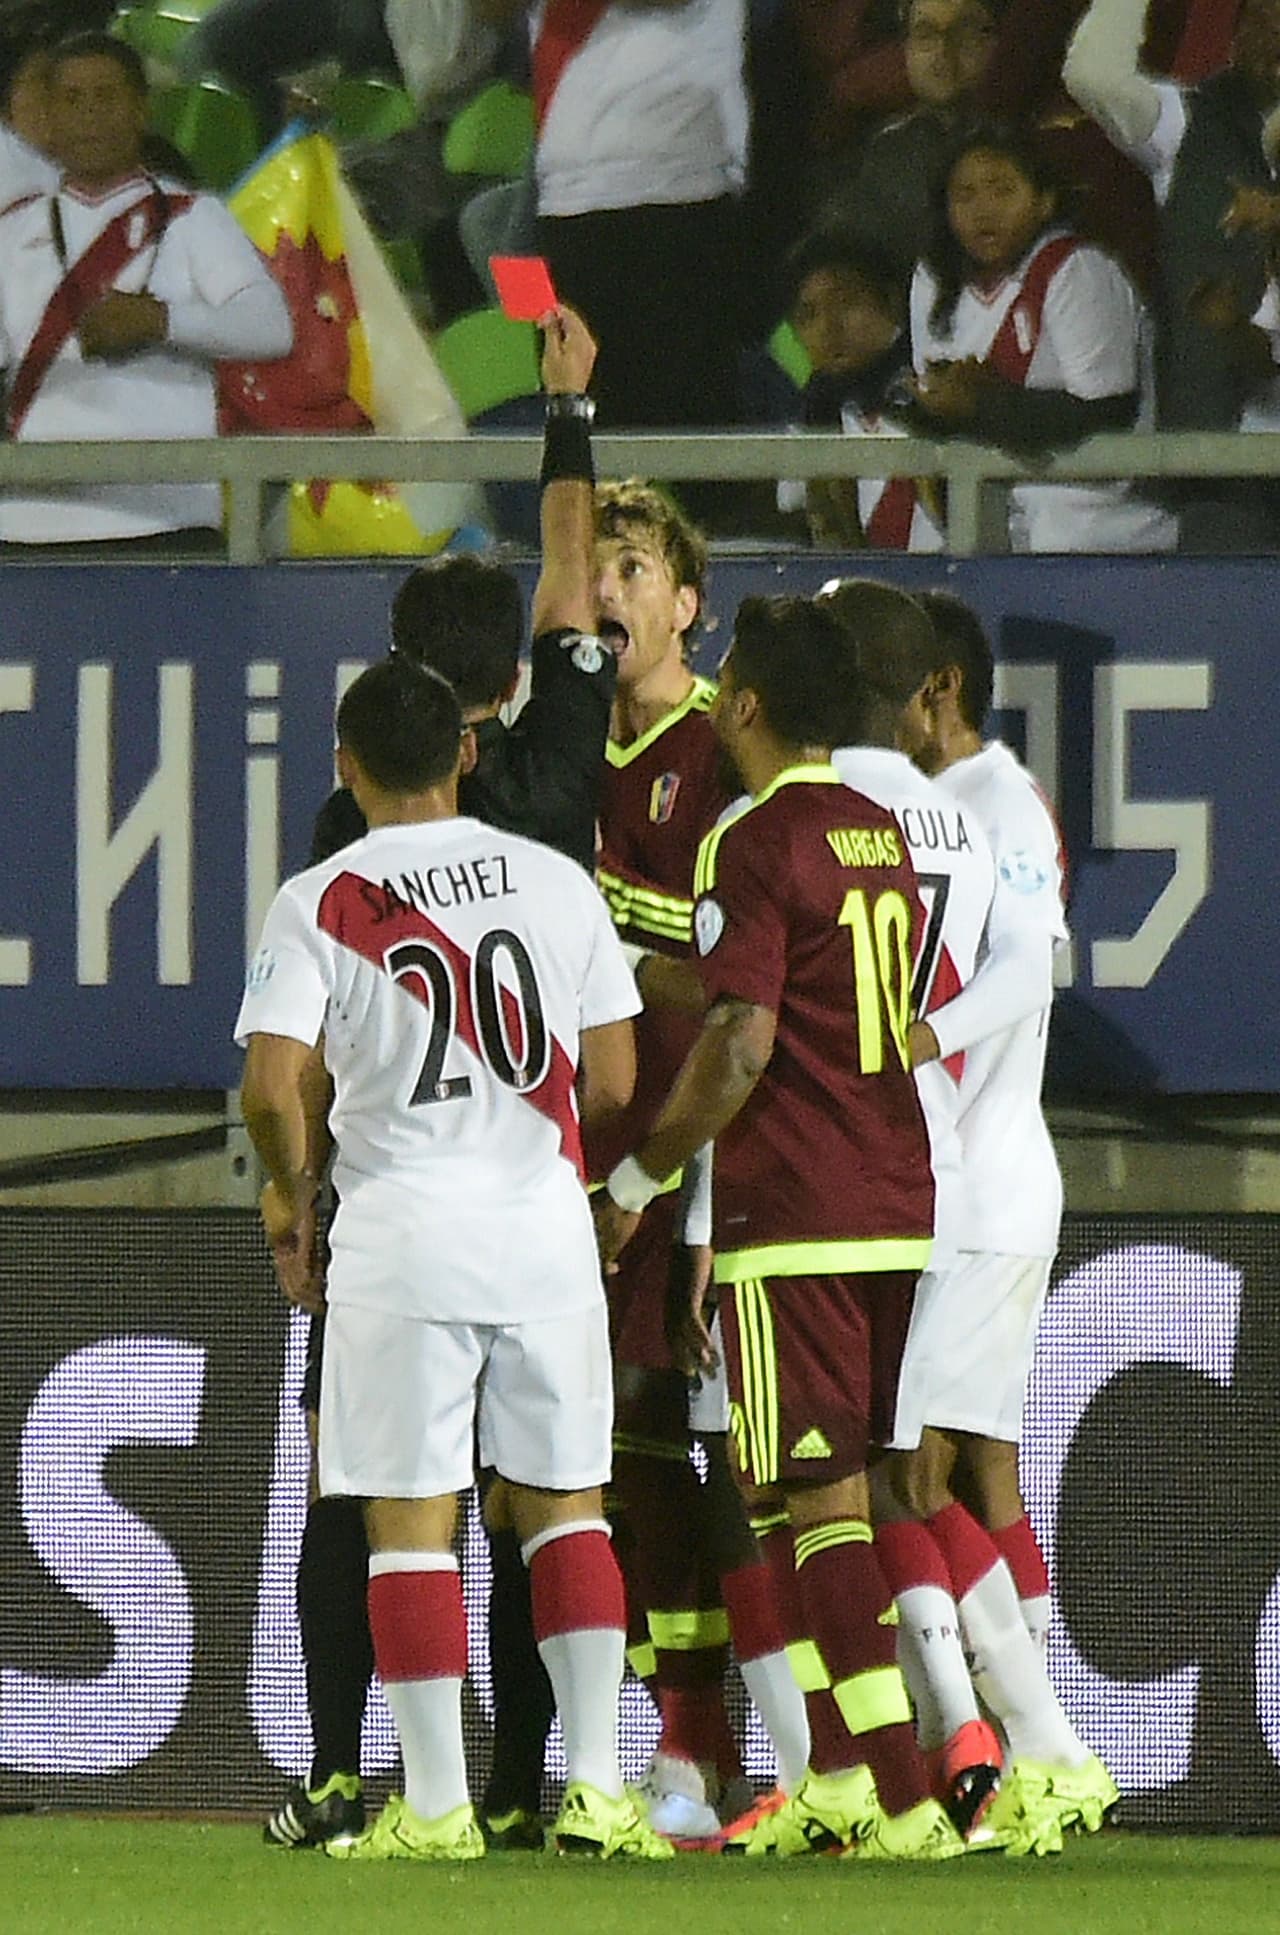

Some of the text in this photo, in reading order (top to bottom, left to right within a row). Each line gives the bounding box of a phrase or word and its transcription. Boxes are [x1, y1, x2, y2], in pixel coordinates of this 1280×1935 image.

[825, 827, 904, 868] VARGAS
[890, 807, 973, 855] CULA
[359, 855, 518, 924] SANCHEZ
[837, 888, 913, 1075] 10
[383, 926, 552, 1110] 20
